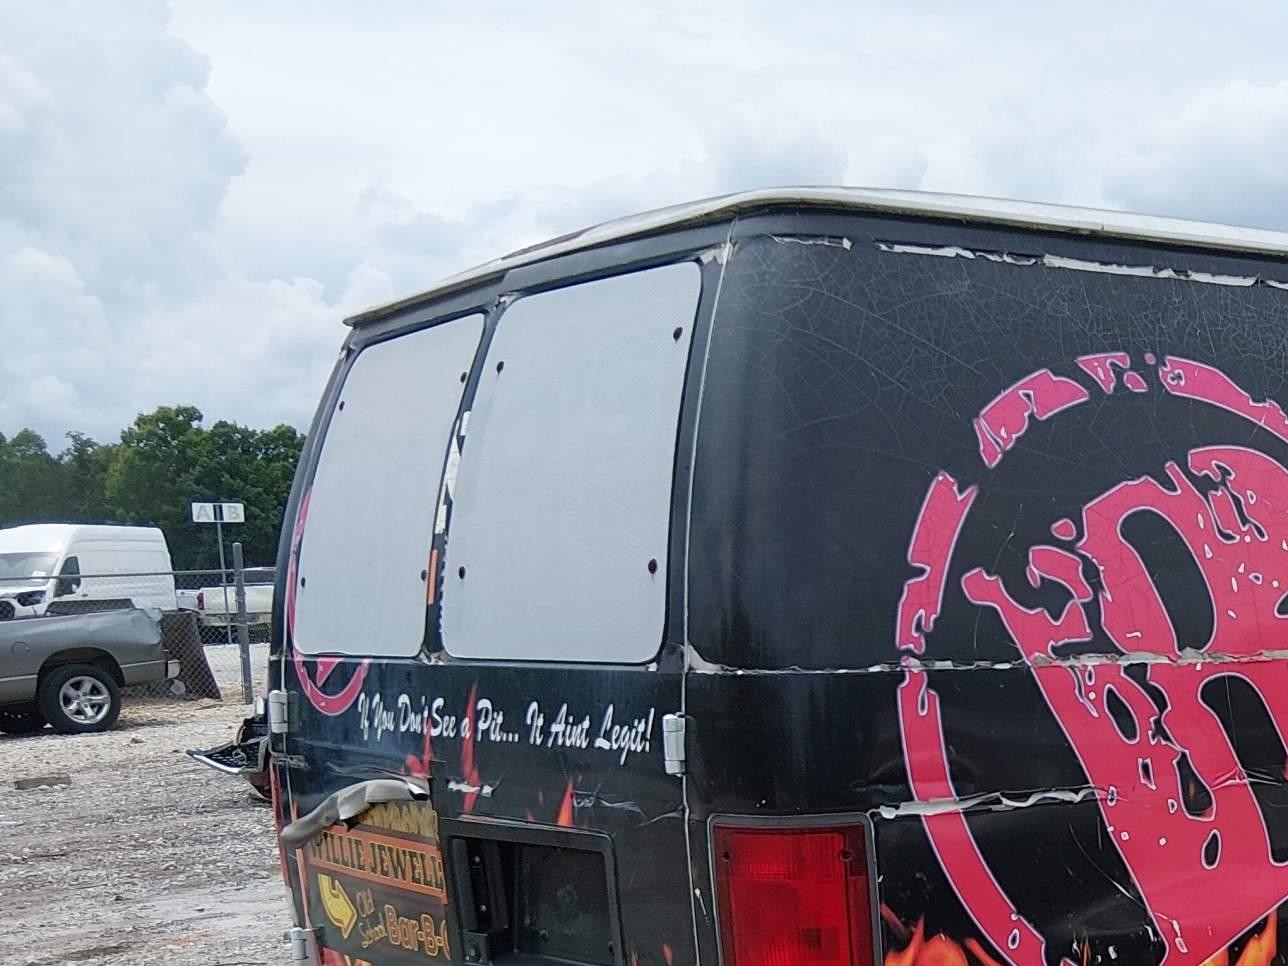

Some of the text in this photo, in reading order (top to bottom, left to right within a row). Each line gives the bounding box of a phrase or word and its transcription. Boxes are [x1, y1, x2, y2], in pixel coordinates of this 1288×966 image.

[228, 505, 241, 520] B
[358, 692, 656, 766] If You Don't See a Pit... It Aint Legit!
